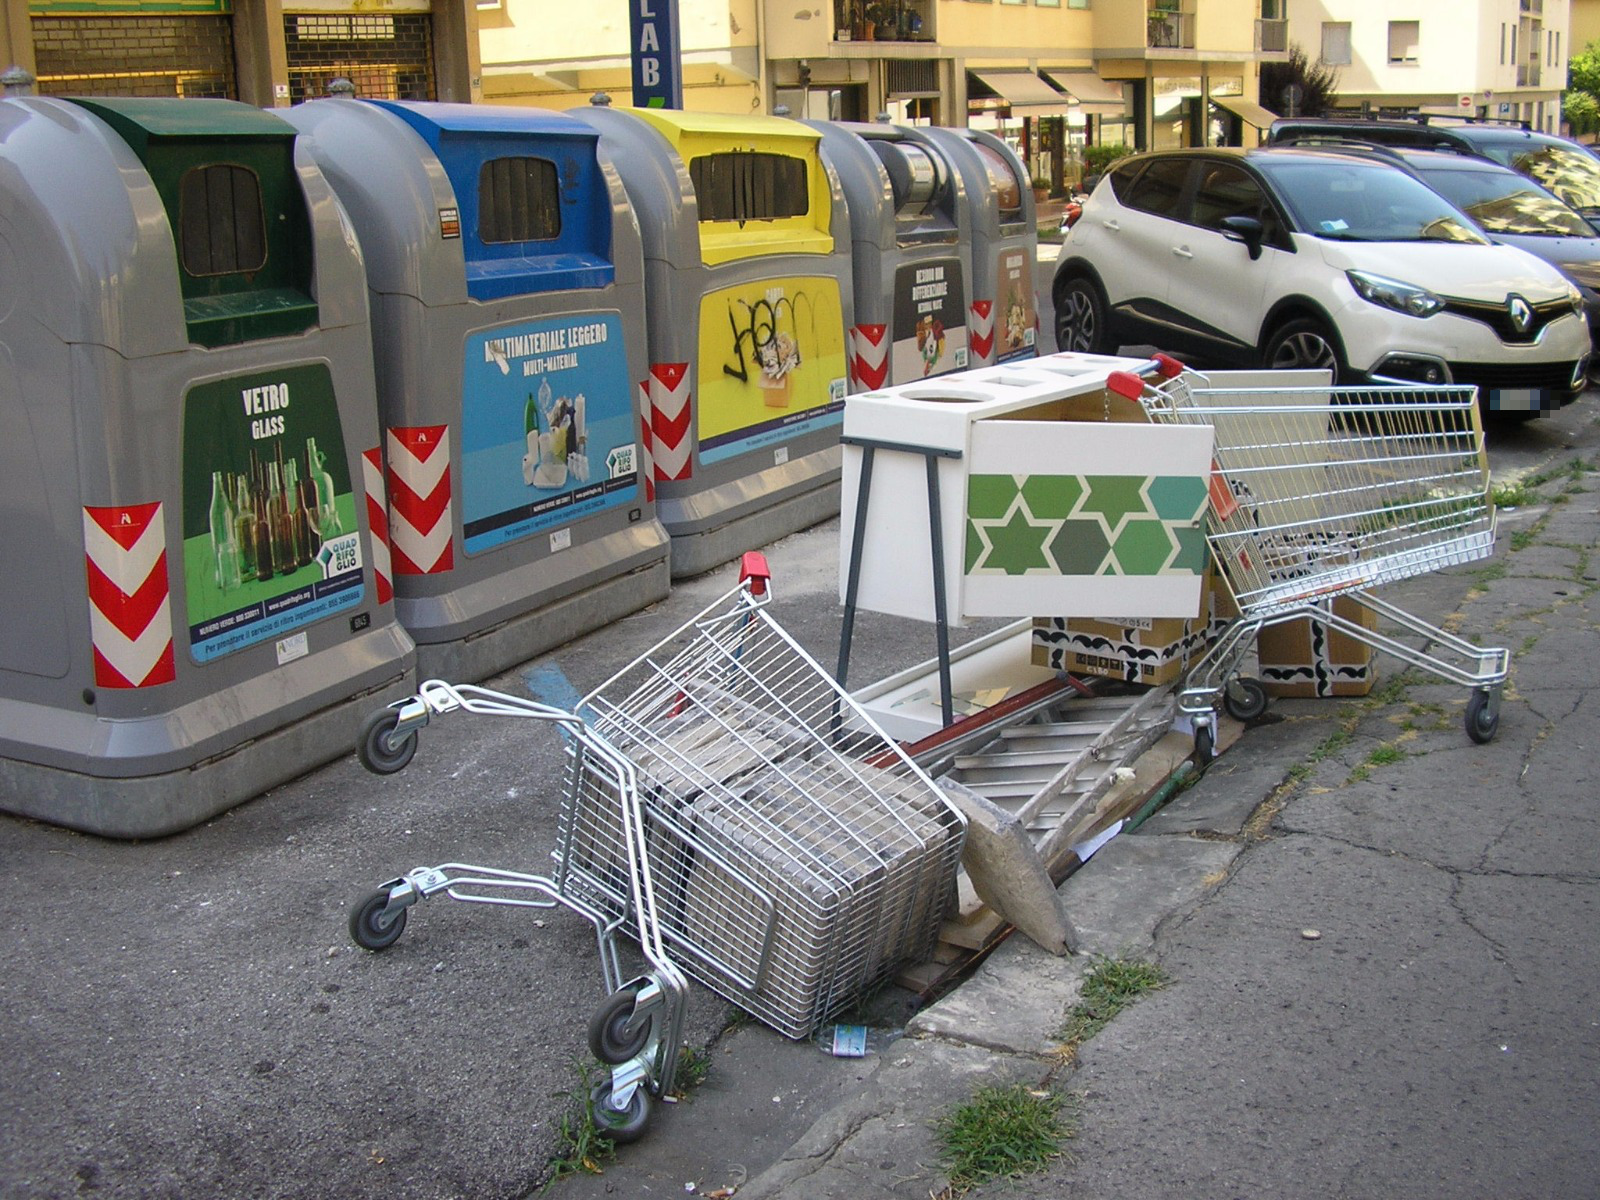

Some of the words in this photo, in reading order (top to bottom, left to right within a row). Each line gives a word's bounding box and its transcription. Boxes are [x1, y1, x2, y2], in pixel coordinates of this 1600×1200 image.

[567, 323, 607, 348] LEGGERO
[523, 352, 578, 376] MULTI-MATERIAL
[242, 382, 289, 416] VETRO
[252, 415, 285, 440] GLASS
[616, 448, 633, 459] QUAD
[617, 456, 631, 466] RIFO
[618, 464, 631, 473] GLIO
[333, 538, 357, 553] QUAD
[335, 548, 356, 562] RIFO
[336, 557, 357, 571] GLIO
[199, 622, 220, 635] NUMERO
[205, 643, 215, 654] Per
[251, 623, 273, 637] servizio
[273, 620, 280, 628] di
